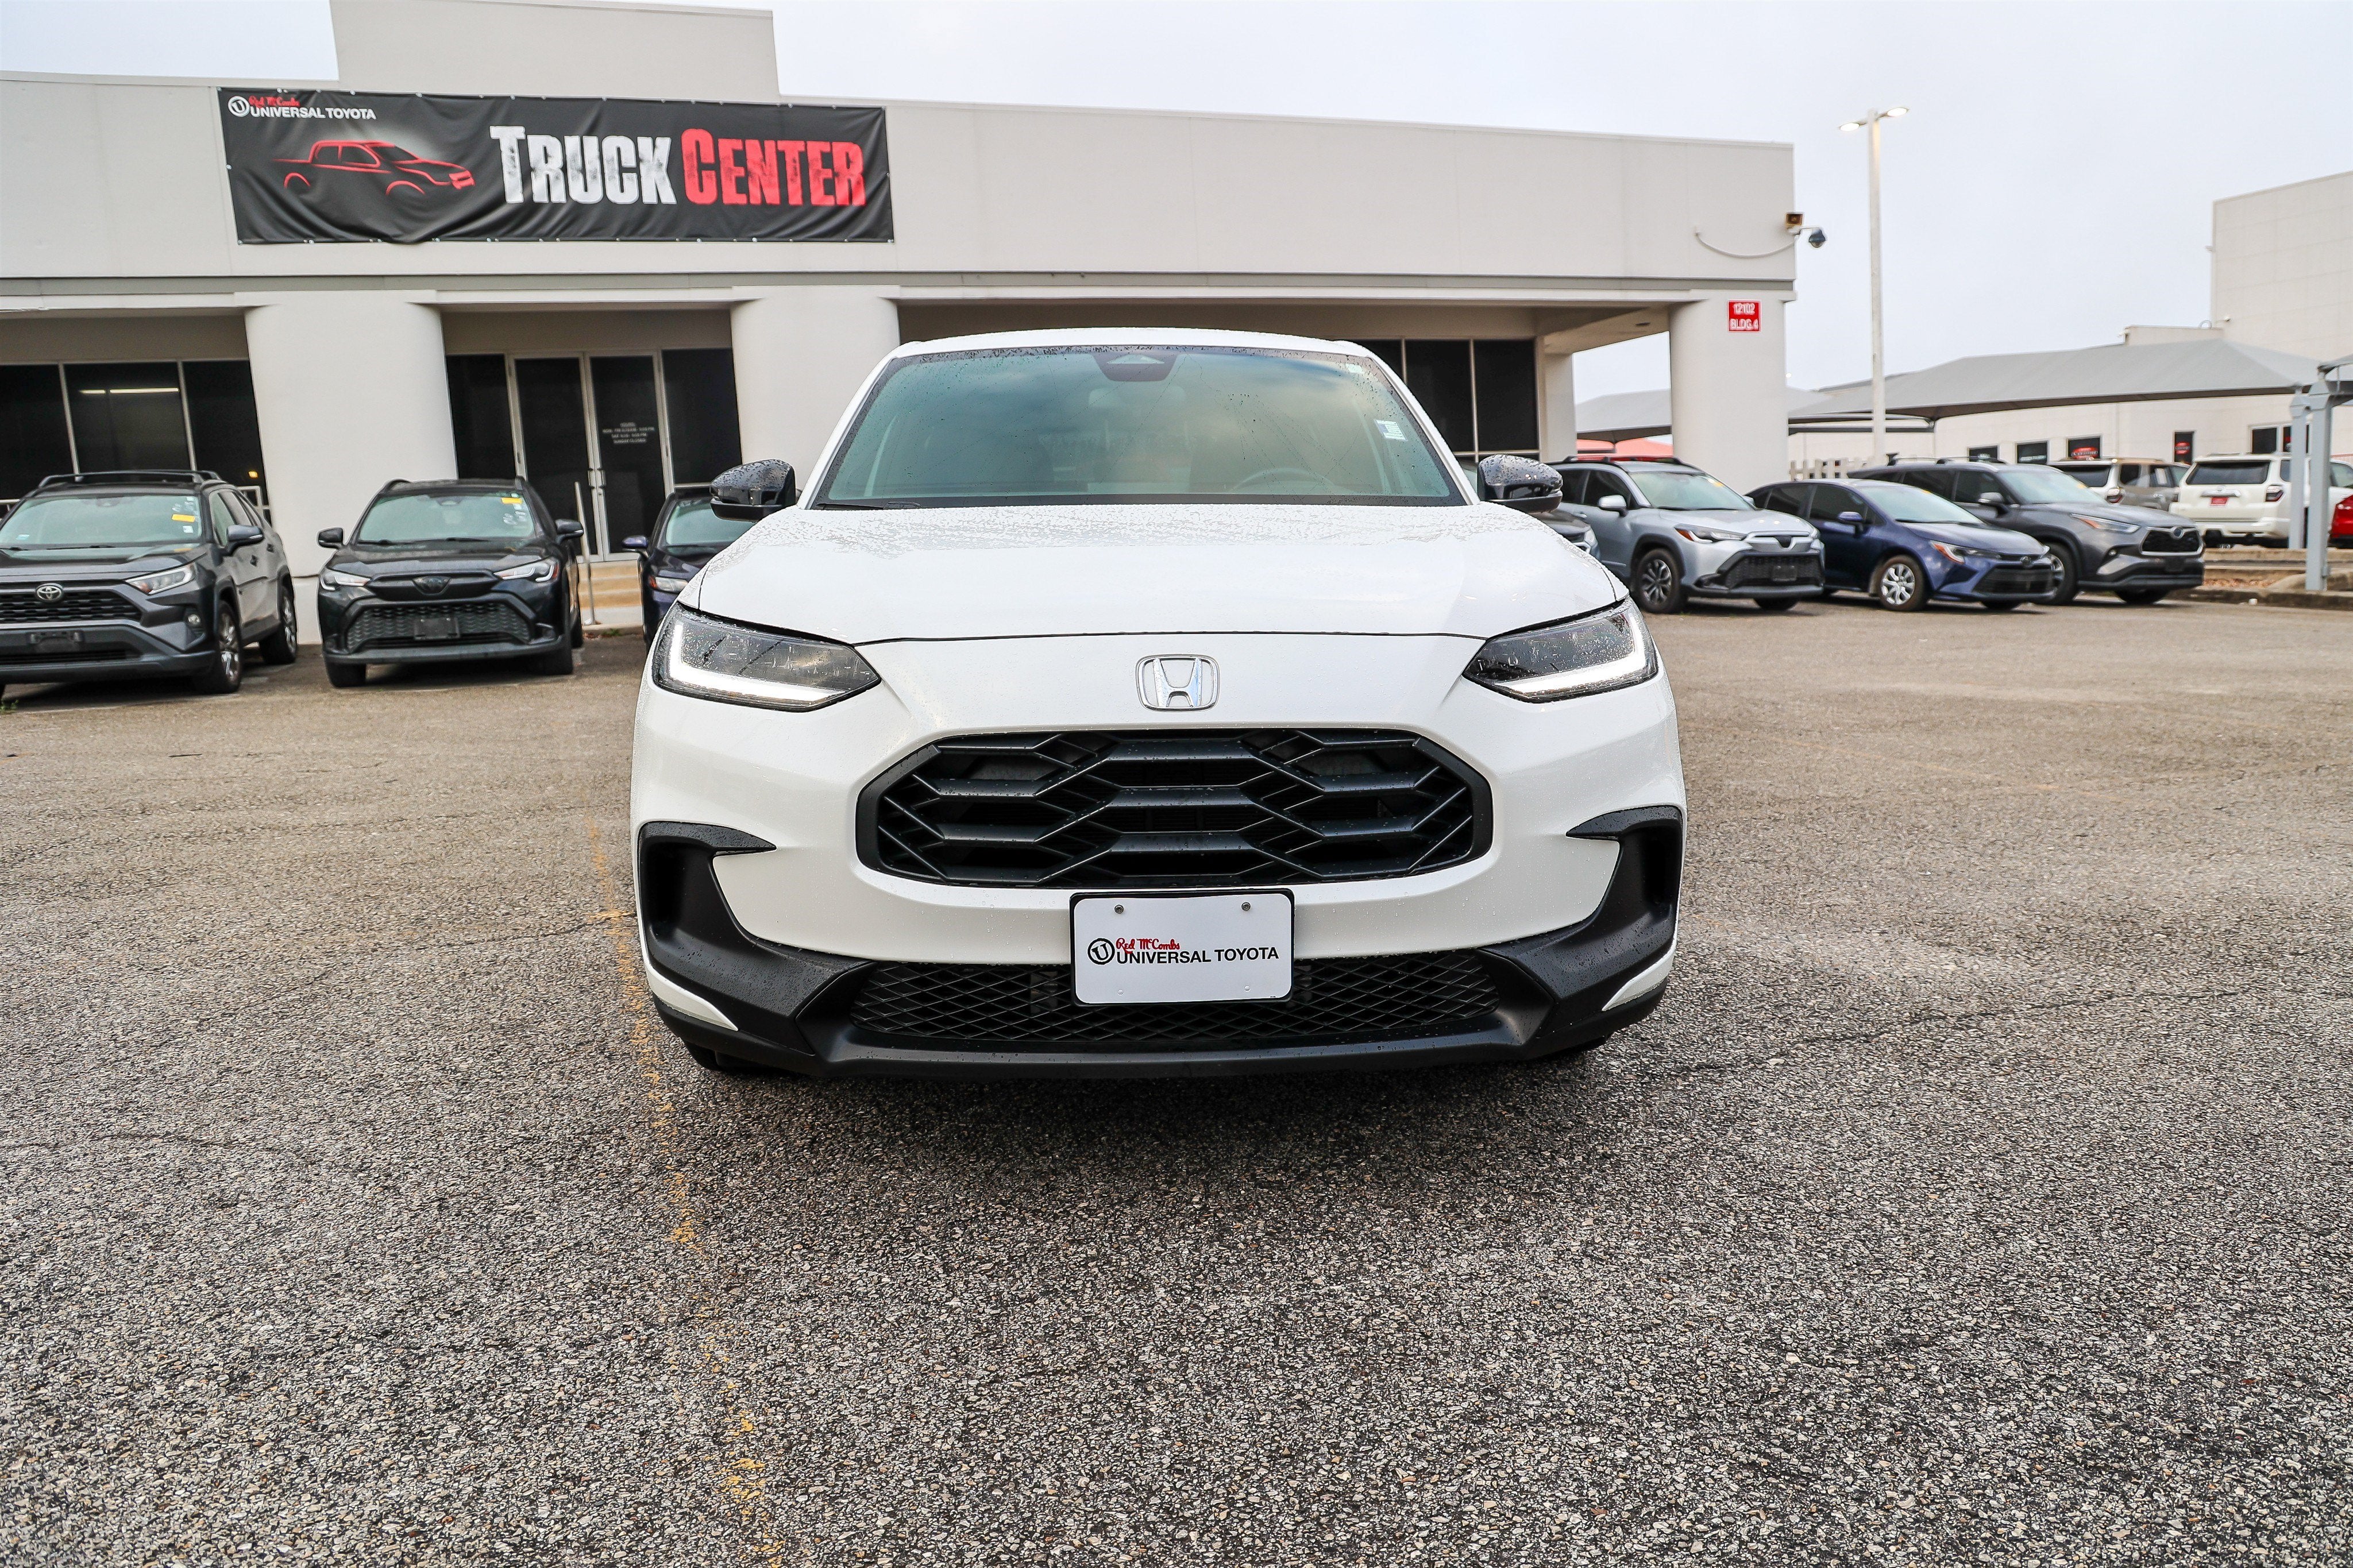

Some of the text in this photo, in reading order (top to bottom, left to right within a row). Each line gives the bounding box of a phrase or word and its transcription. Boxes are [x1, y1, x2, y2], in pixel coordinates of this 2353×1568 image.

[250, 106, 377, 119] UNIVERSAL TOYOTA
[489, 126, 866, 206] TRUCK CENTER
[1733, 302, 1756, 314] 12102
[1116, 938, 1181, 954] Red McCombs
[1117, 947, 1279, 964] UNIVERSAL TOYOTA
